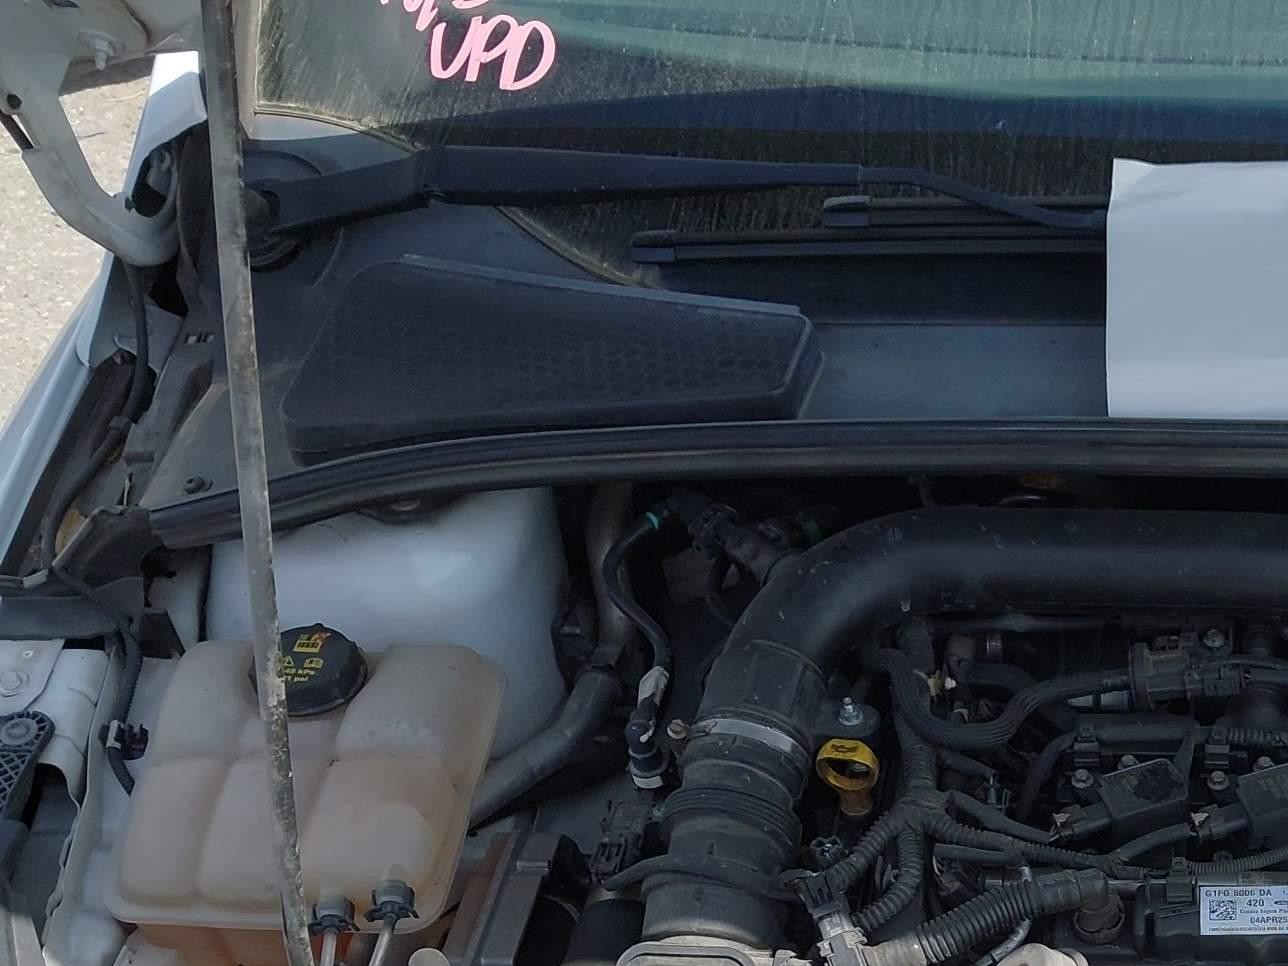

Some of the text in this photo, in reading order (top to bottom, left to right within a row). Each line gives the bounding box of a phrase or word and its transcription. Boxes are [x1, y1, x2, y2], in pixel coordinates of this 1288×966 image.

[430, 14, 556, 90] UPD
[1259, 889, 1272, 897] DA
[1246, 899, 1265, 907] 420
